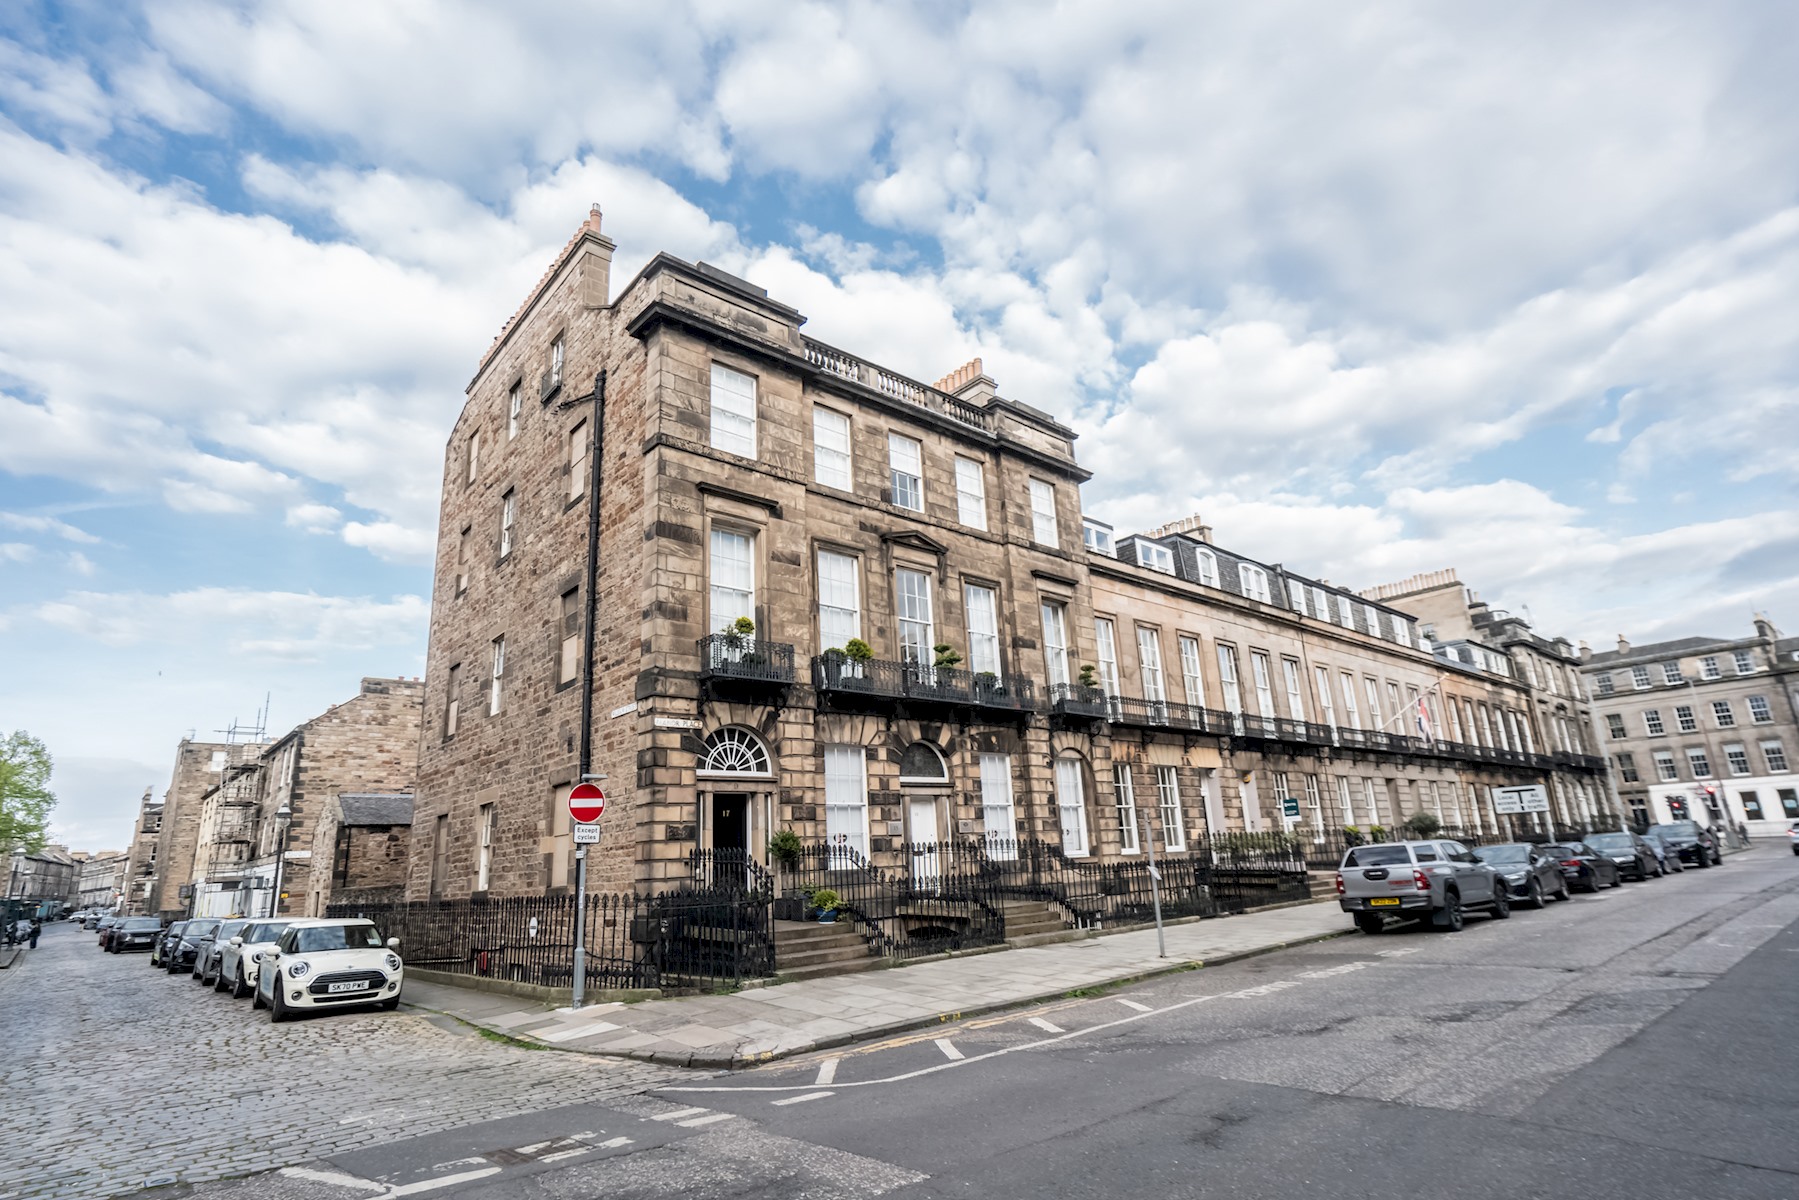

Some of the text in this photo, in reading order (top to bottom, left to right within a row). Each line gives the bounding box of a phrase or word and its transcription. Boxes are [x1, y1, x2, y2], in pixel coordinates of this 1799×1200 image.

[682, 720, 702, 728] PLACE
[332, 981, 367, 991] SK70 PWE
